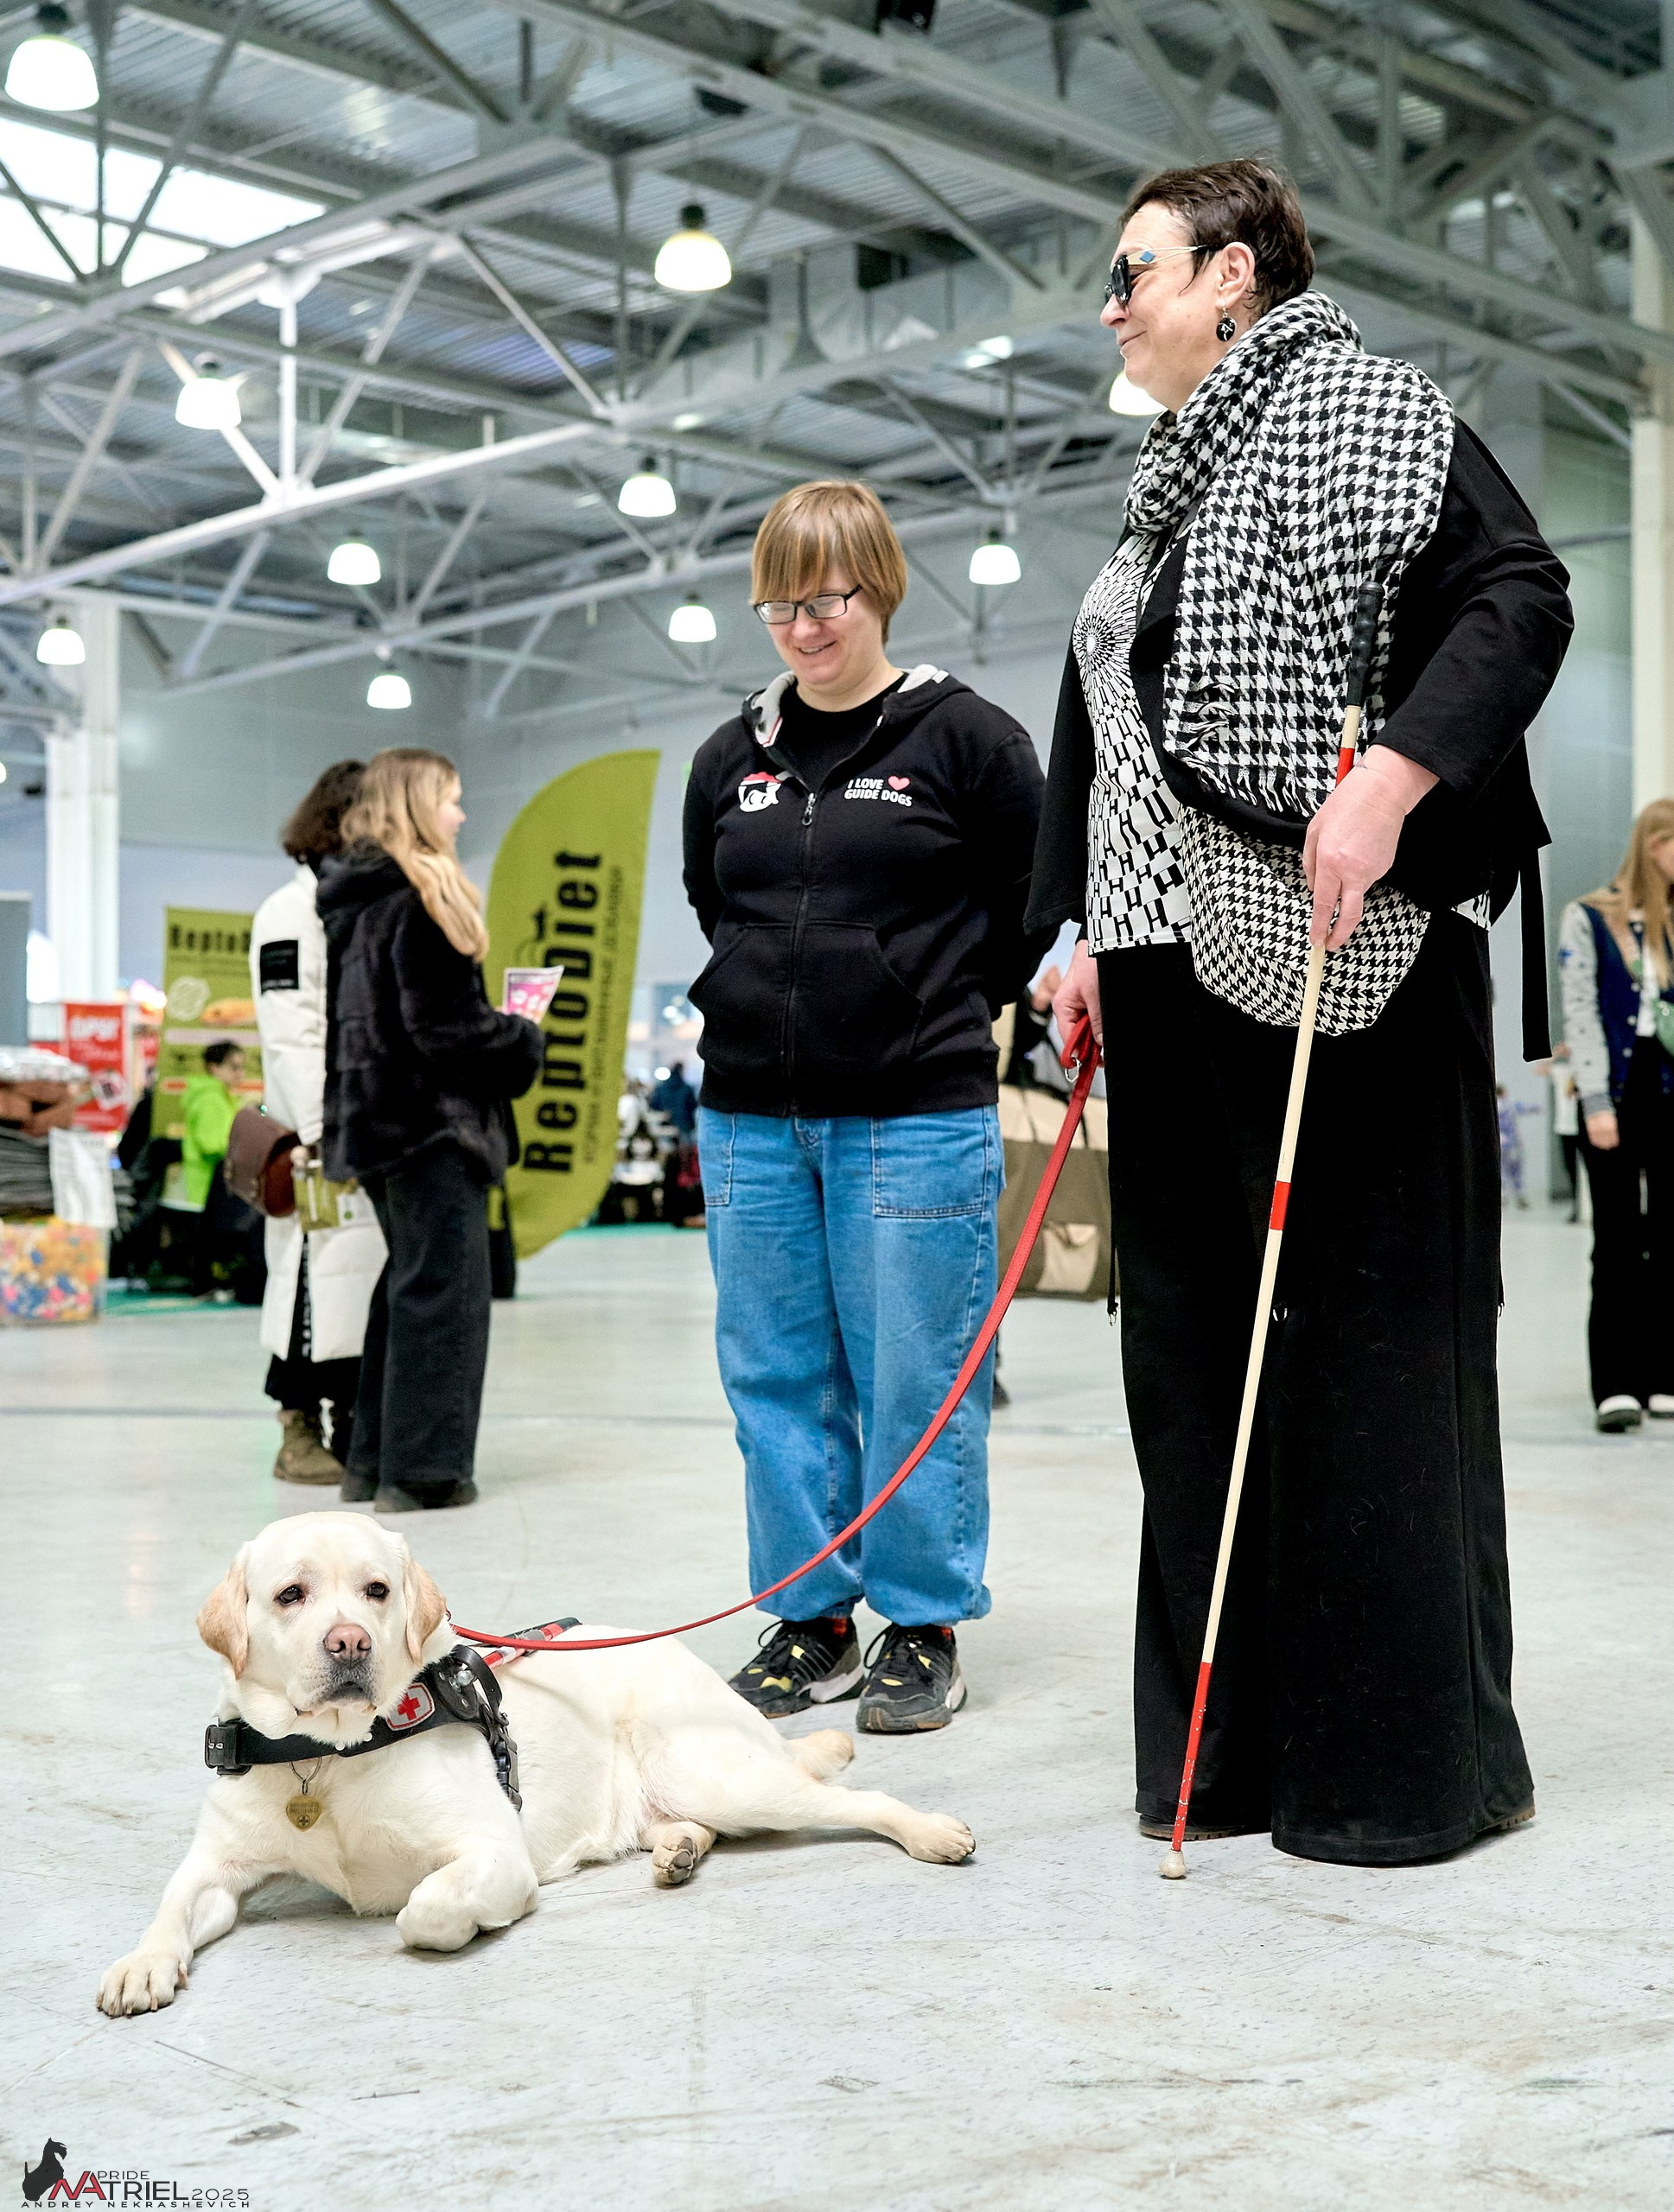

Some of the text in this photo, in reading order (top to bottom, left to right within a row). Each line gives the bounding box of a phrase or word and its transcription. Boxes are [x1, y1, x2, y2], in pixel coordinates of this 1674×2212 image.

[847, 778, 884, 790] I LOVE
[844, 789, 913, 807] GUIDE DOGS
[169, 924, 252, 955] ReptoD
